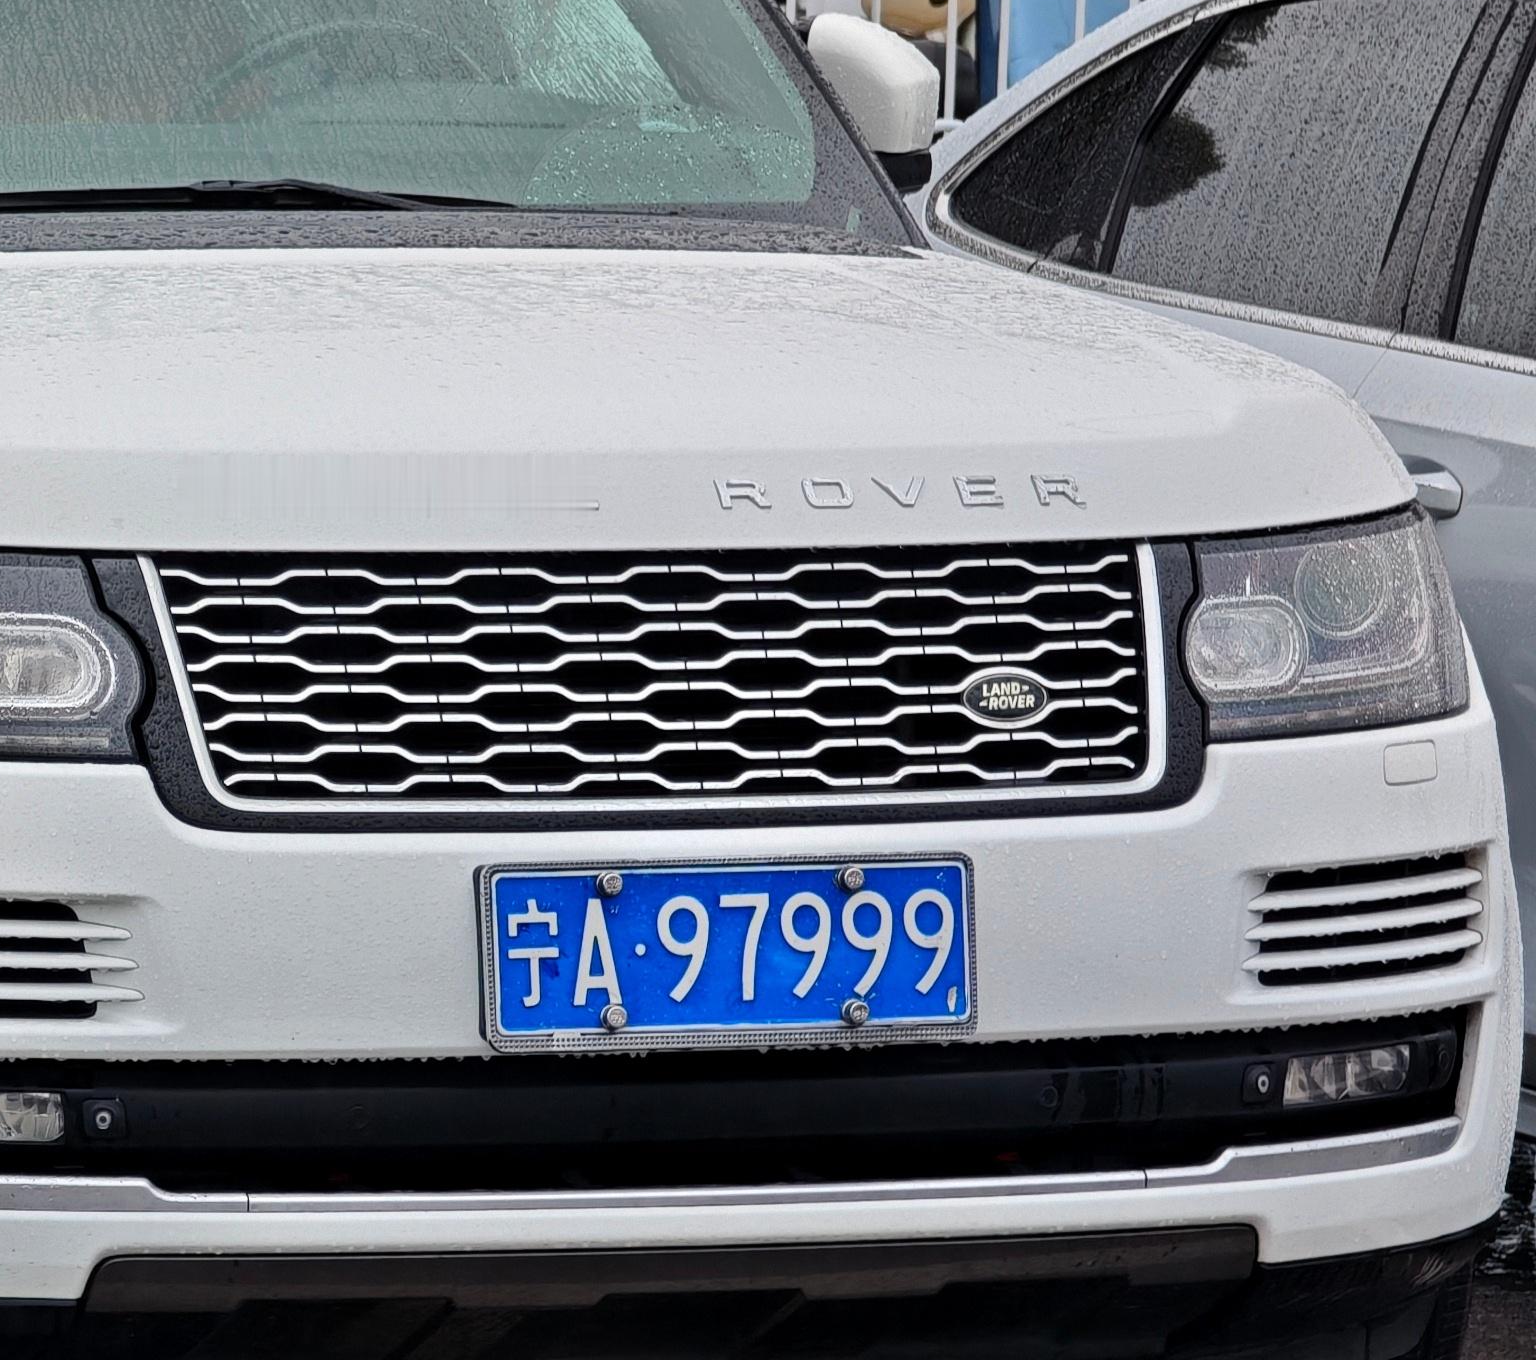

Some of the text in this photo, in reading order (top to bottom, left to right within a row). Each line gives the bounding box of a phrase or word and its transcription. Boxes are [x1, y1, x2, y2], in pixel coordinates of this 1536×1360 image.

[713, 473, 1087, 510] ROVER
[982, 681, 1021, 697] LAND
[988, 694, 1036, 711] ROVER
